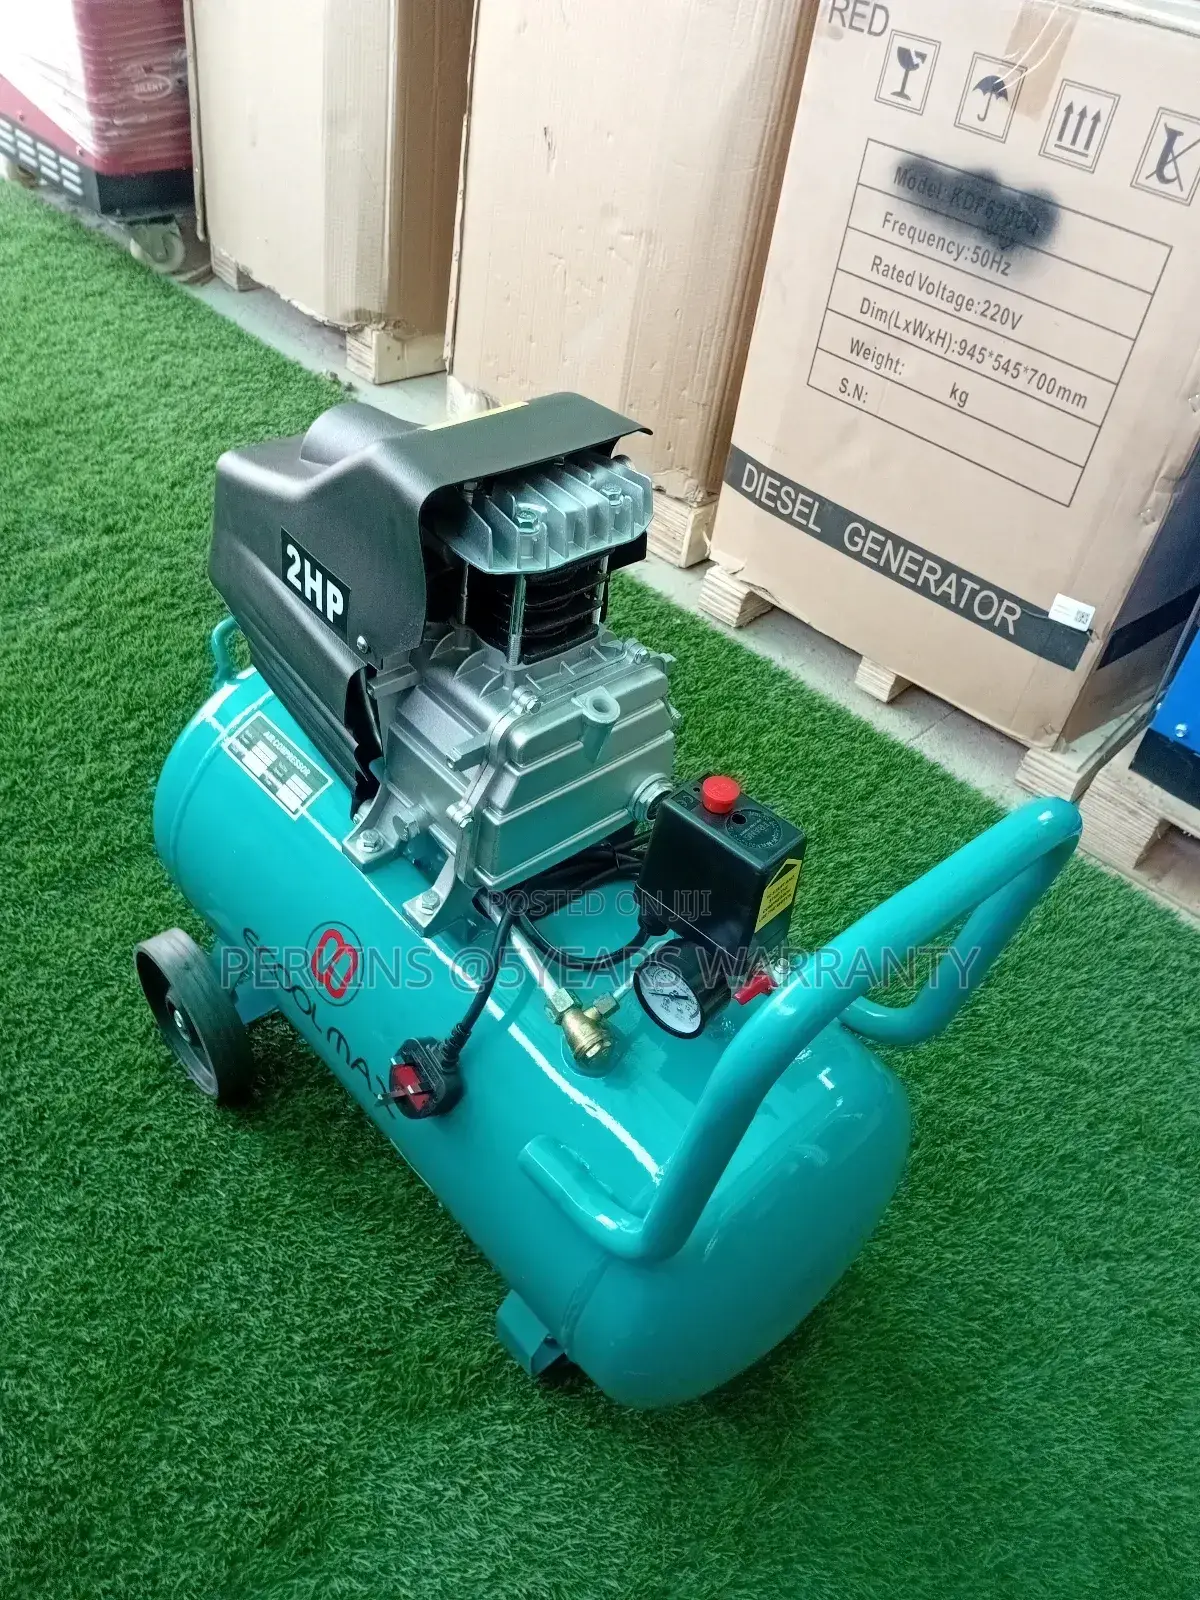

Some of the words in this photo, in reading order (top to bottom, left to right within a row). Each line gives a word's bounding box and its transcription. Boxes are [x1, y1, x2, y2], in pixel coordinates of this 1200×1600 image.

[828, 0, 889, 37] RED
[882, 211, 1012, 277] Frequency:50Hz
[870, 255, 915, 289] Rated
[917, 265, 1024, 330] Voltage:220V
[839, 377, 869, 404] S.N:
[850, 337, 905, 376] Weight:
[949, 383, 970, 408] kg
[740, 462, 823, 533] DIESEL
[843, 521, 1022, 636] GENERATOR
[286, 543, 345, 624] 2HP
[272, 740, 311, 777] COMPRESSOR
